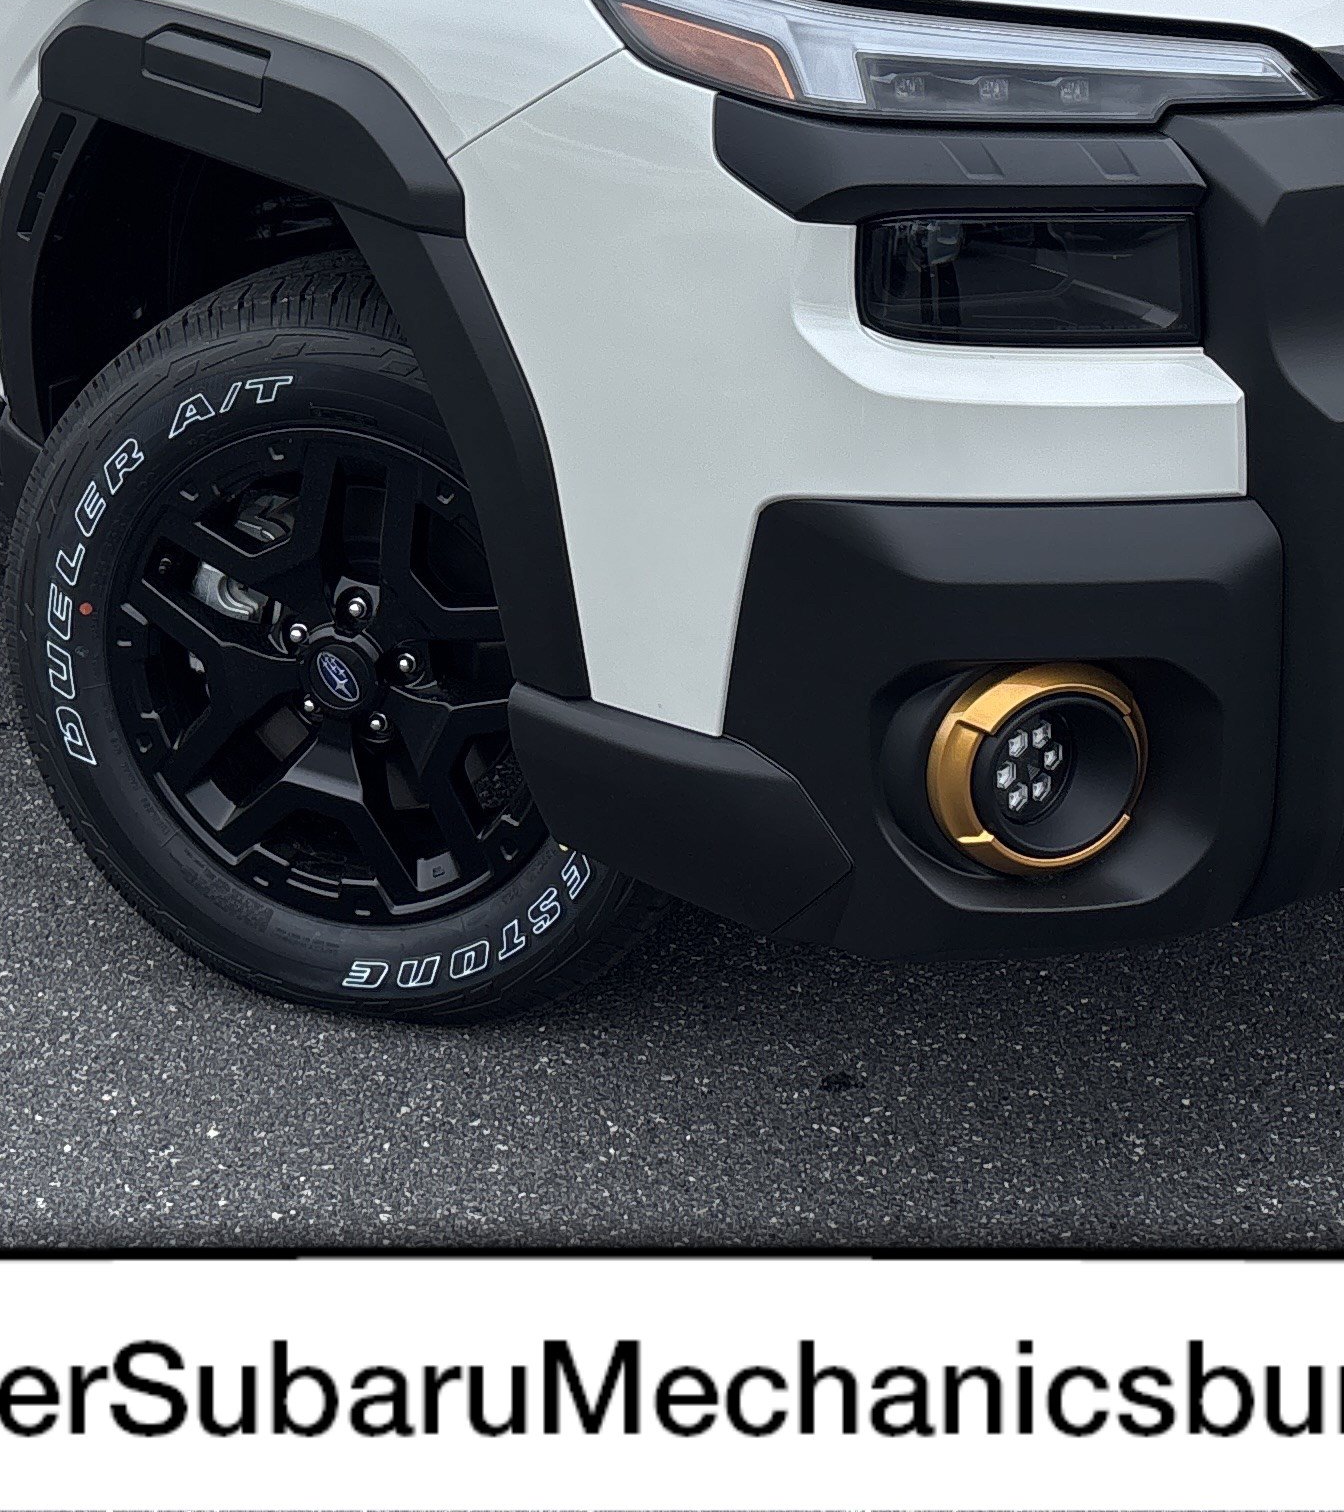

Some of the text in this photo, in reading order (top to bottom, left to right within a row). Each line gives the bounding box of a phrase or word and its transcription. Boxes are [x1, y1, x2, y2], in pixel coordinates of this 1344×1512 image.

[46, 375, 294, 766] DUELER A/T
[341, 844, 592, 990] ESTONE
